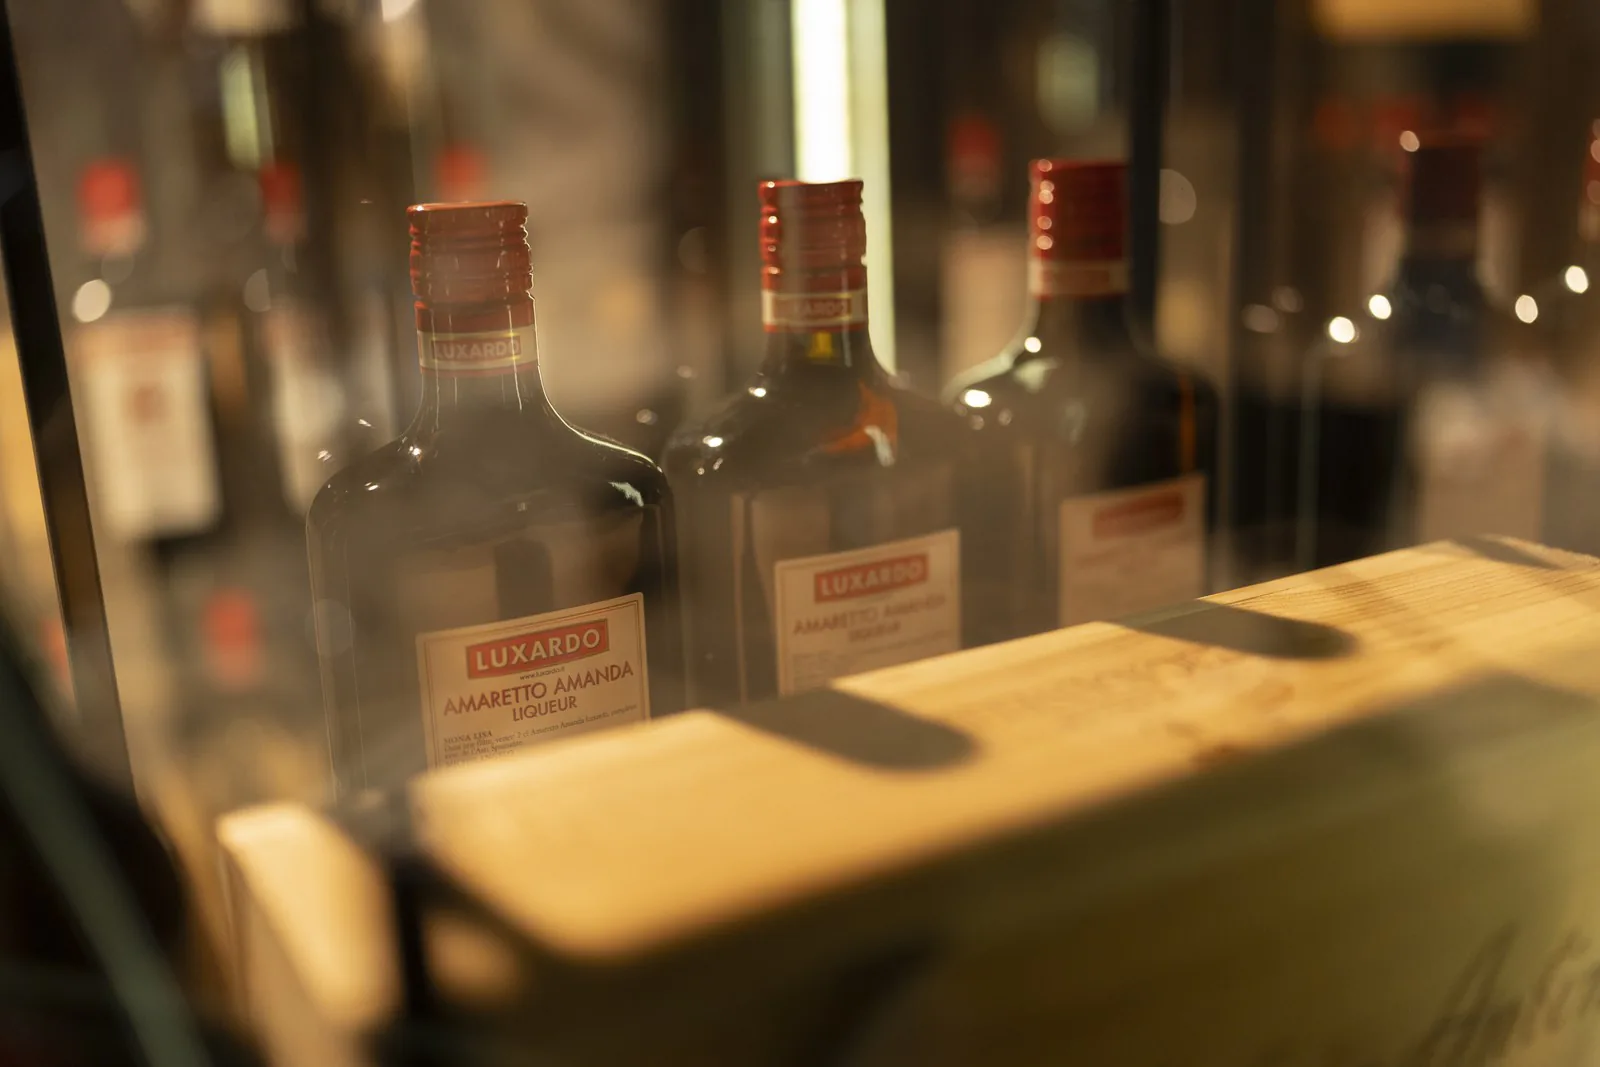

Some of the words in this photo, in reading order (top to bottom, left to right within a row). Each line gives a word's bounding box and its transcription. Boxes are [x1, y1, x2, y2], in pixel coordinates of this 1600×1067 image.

[434, 340, 519, 360] LUXARDO
[820, 558, 924, 596] LUXARDO
[476, 628, 600, 671] LUXARDO
[443, 682, 547, 716] AMARETTO
[553, 660, 634, 695] AMANDA
[519, 666, 565, 680] www.luxardo.it
[512, 695, 578, 722] LIQUEUR
